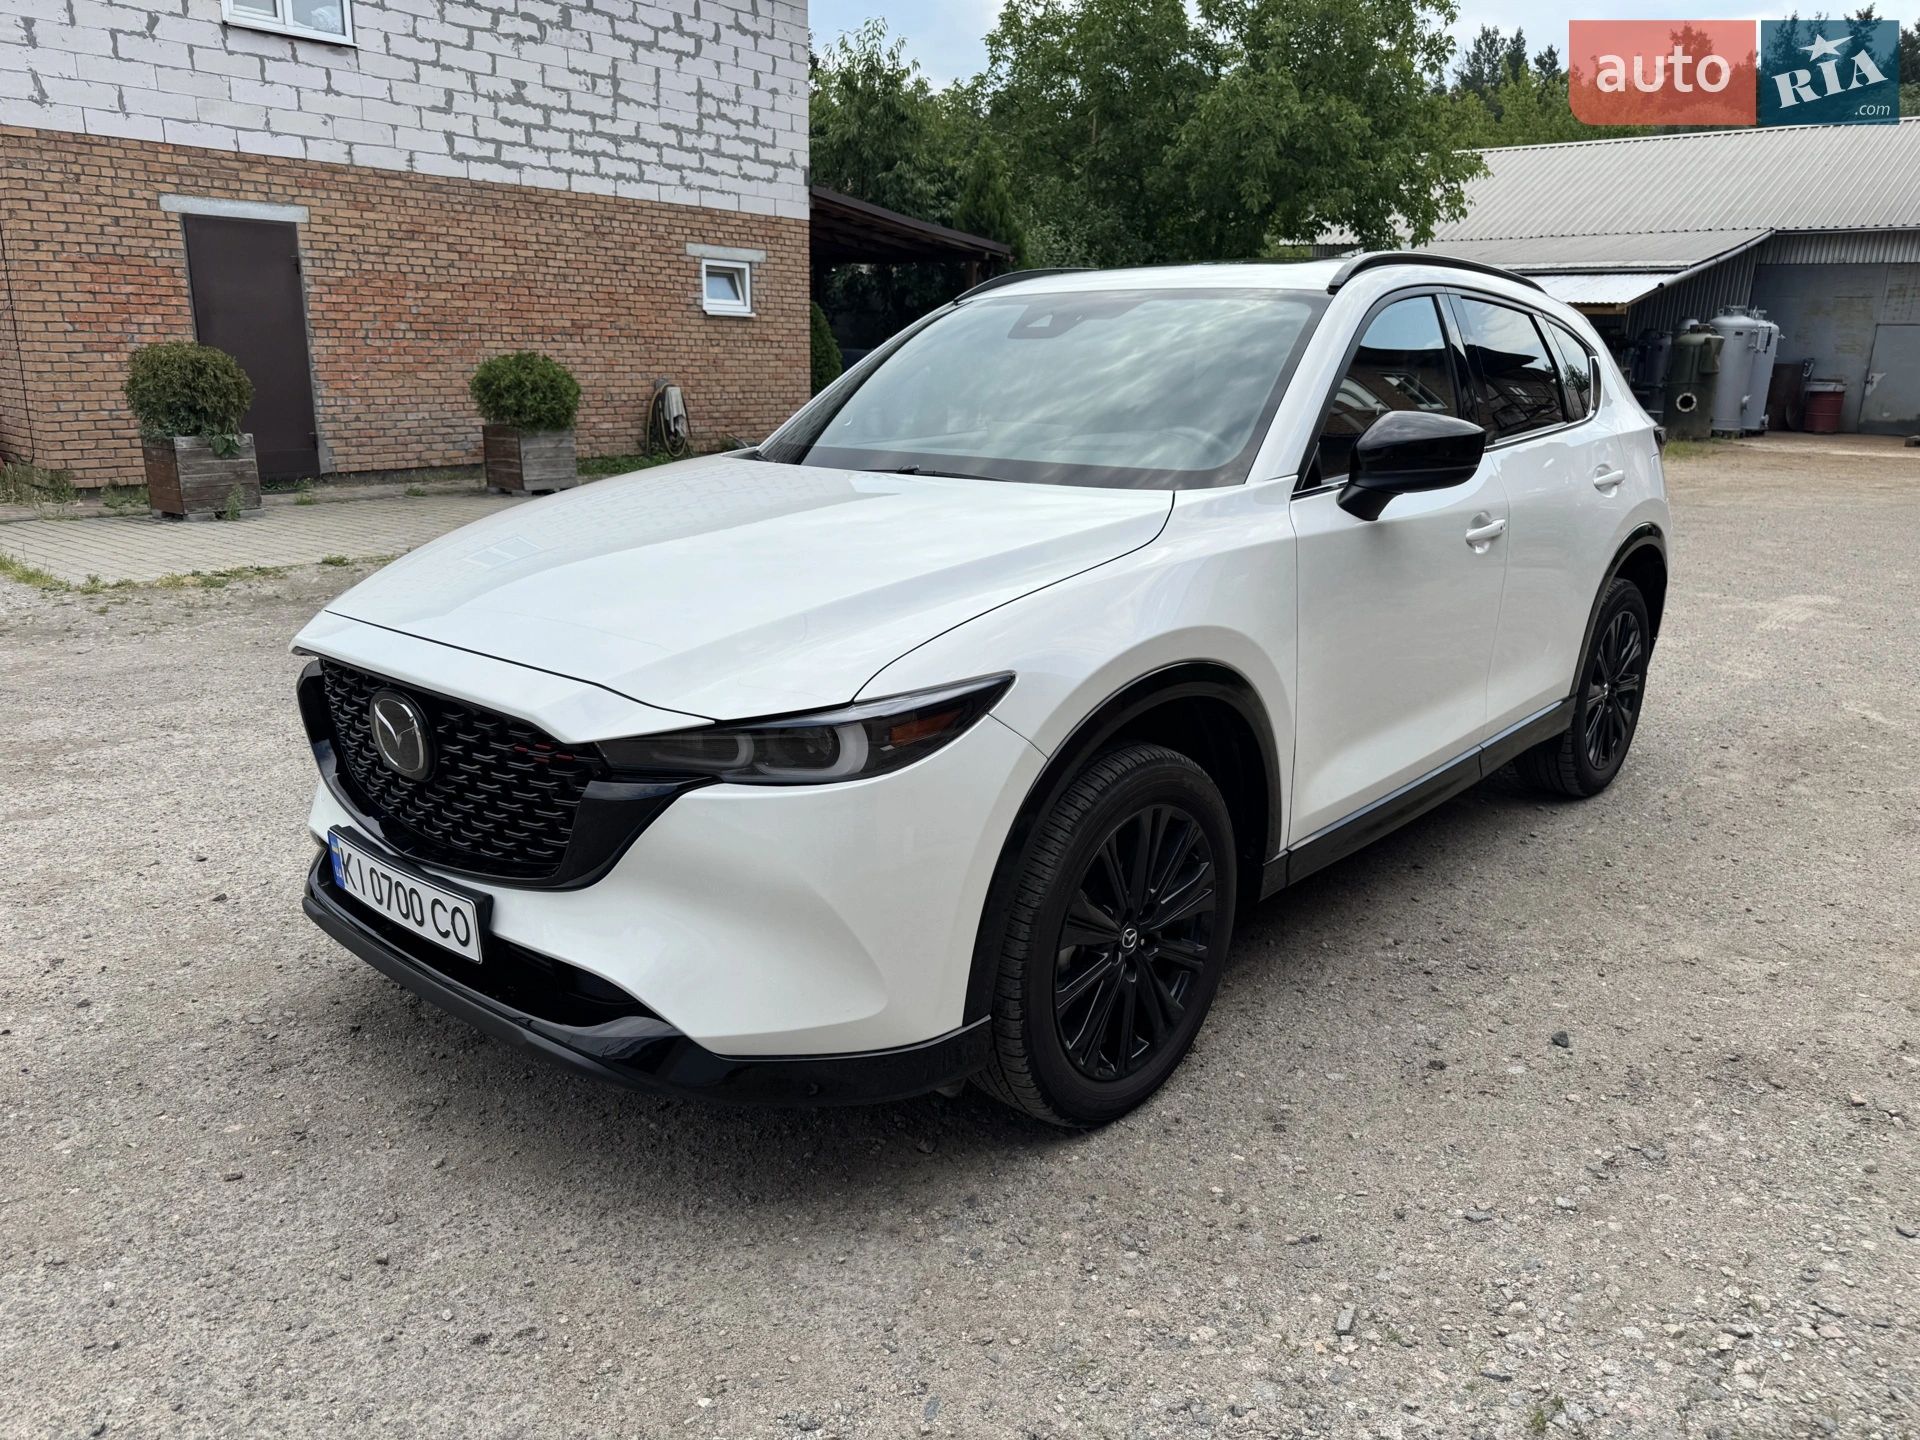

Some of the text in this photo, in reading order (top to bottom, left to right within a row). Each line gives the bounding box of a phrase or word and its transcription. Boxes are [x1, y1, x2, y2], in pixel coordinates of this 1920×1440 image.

[340, 847, 470, 947] KI 0700 CO
